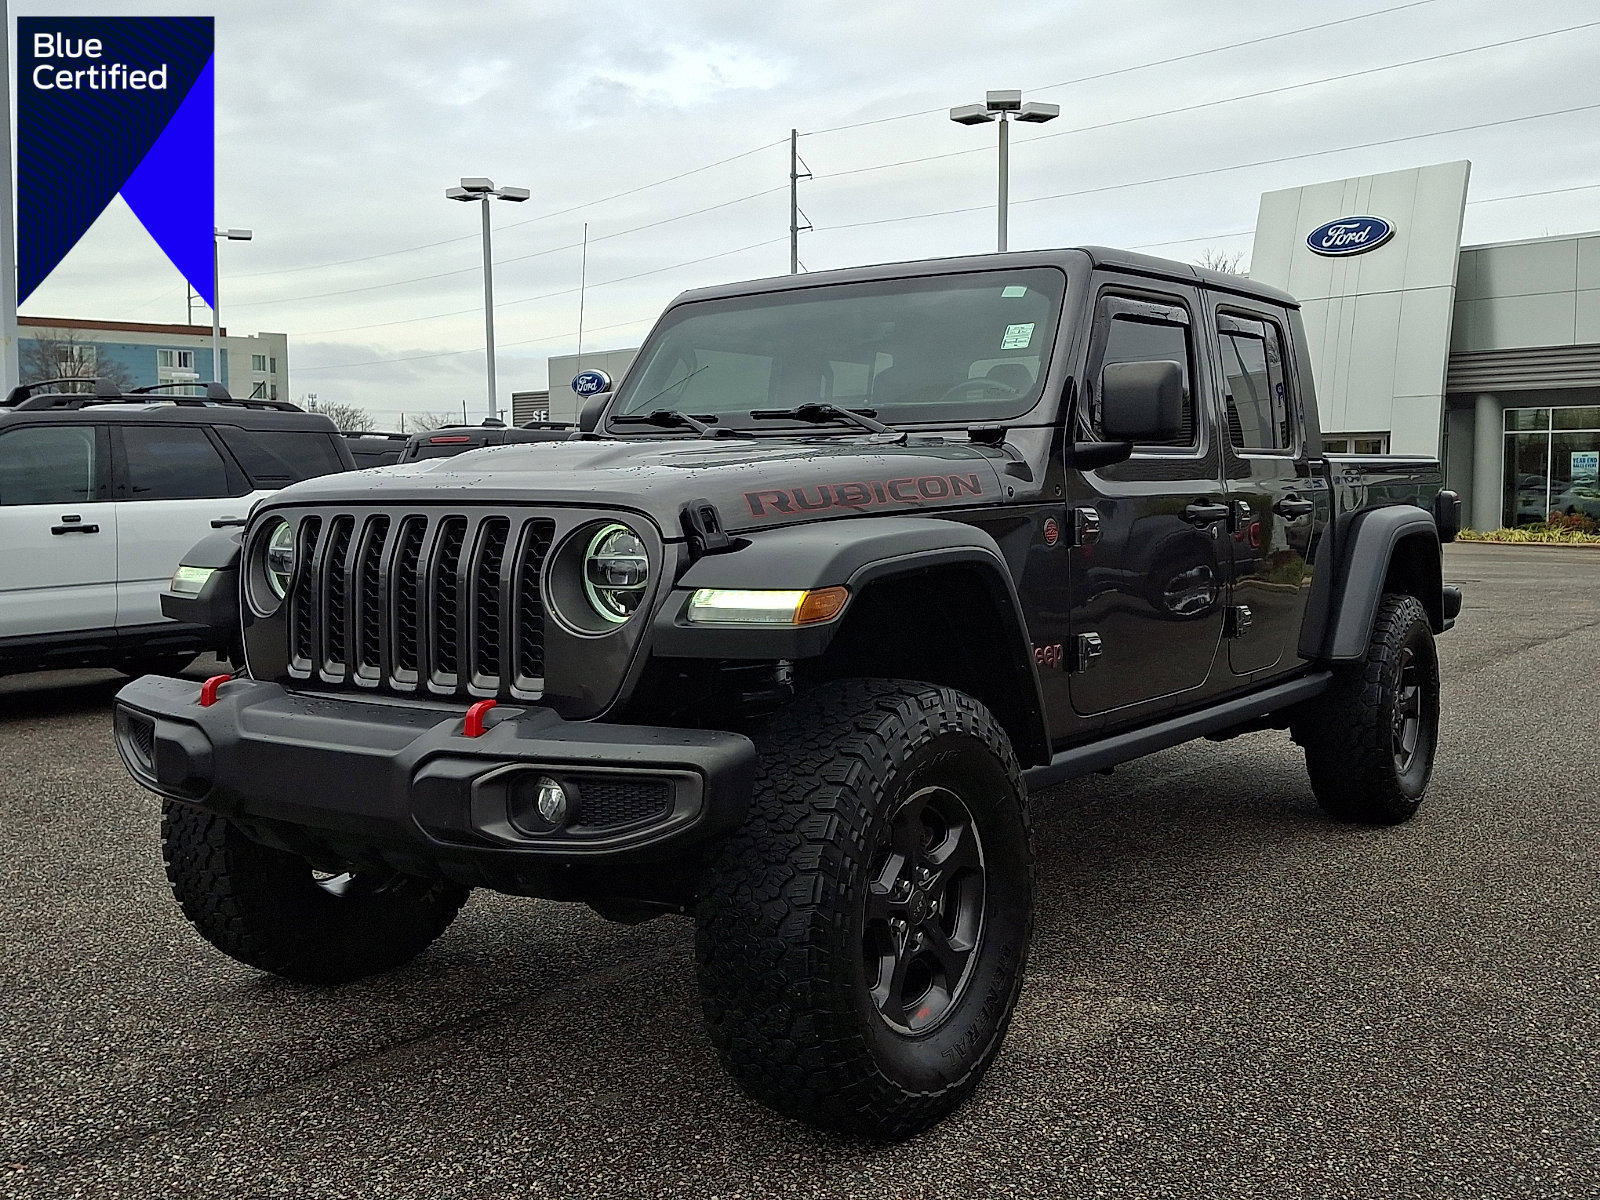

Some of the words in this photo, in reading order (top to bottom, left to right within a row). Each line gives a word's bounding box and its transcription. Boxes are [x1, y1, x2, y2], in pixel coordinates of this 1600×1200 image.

[1322, 222, 1372, 248] Ford
[577, 376, 598, 392] Ford
[744, 474, 983, 517] RUBICON
[1034, 644, 1062, 668] eep
